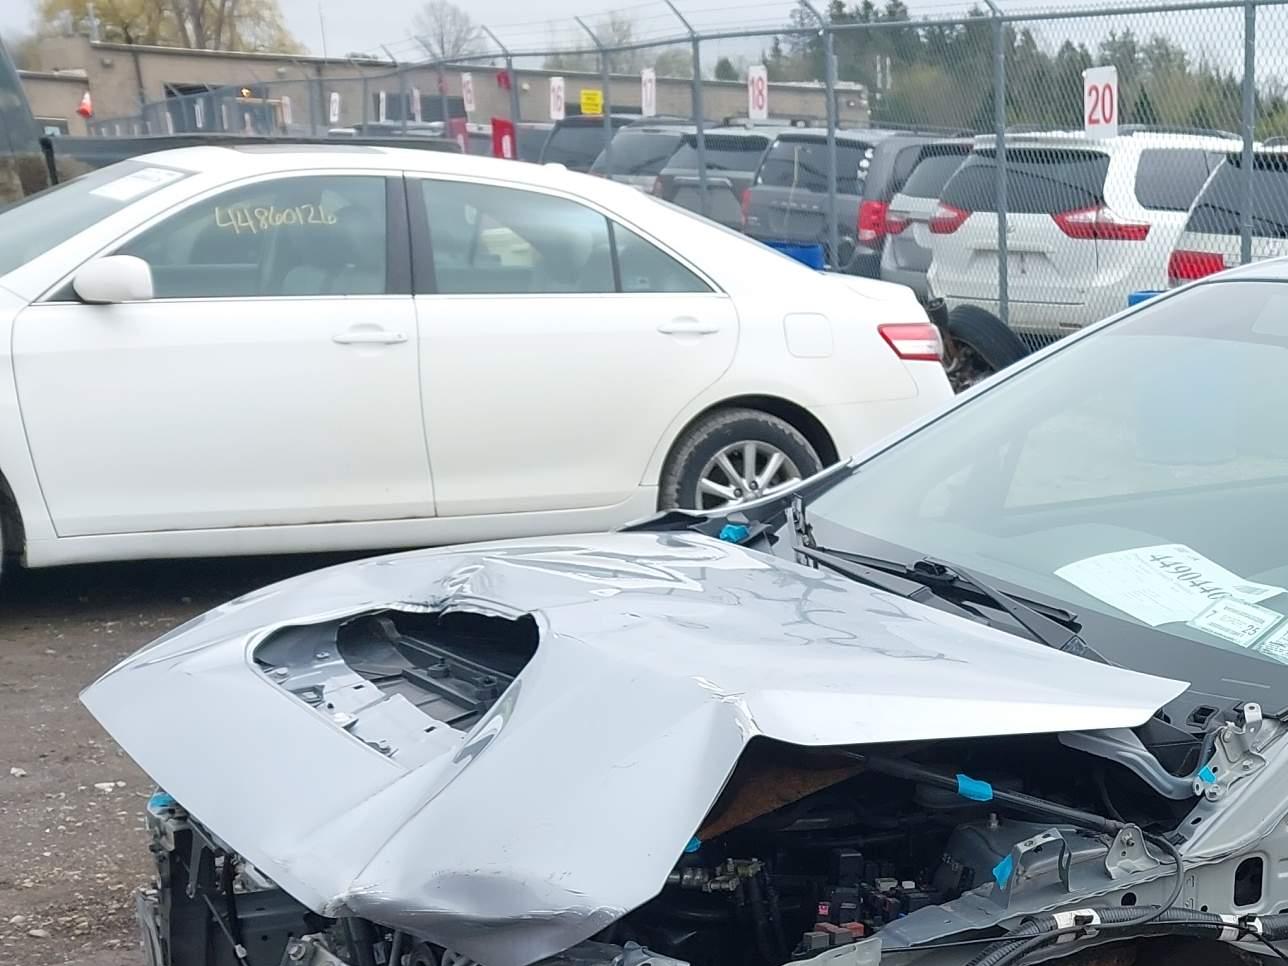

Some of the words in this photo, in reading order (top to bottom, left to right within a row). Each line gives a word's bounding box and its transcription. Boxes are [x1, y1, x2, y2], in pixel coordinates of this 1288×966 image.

[751, 76, 765, 110] 18
[1087, 83, 1115, 125] 20
[215, 203, 337, 234] 44860126
